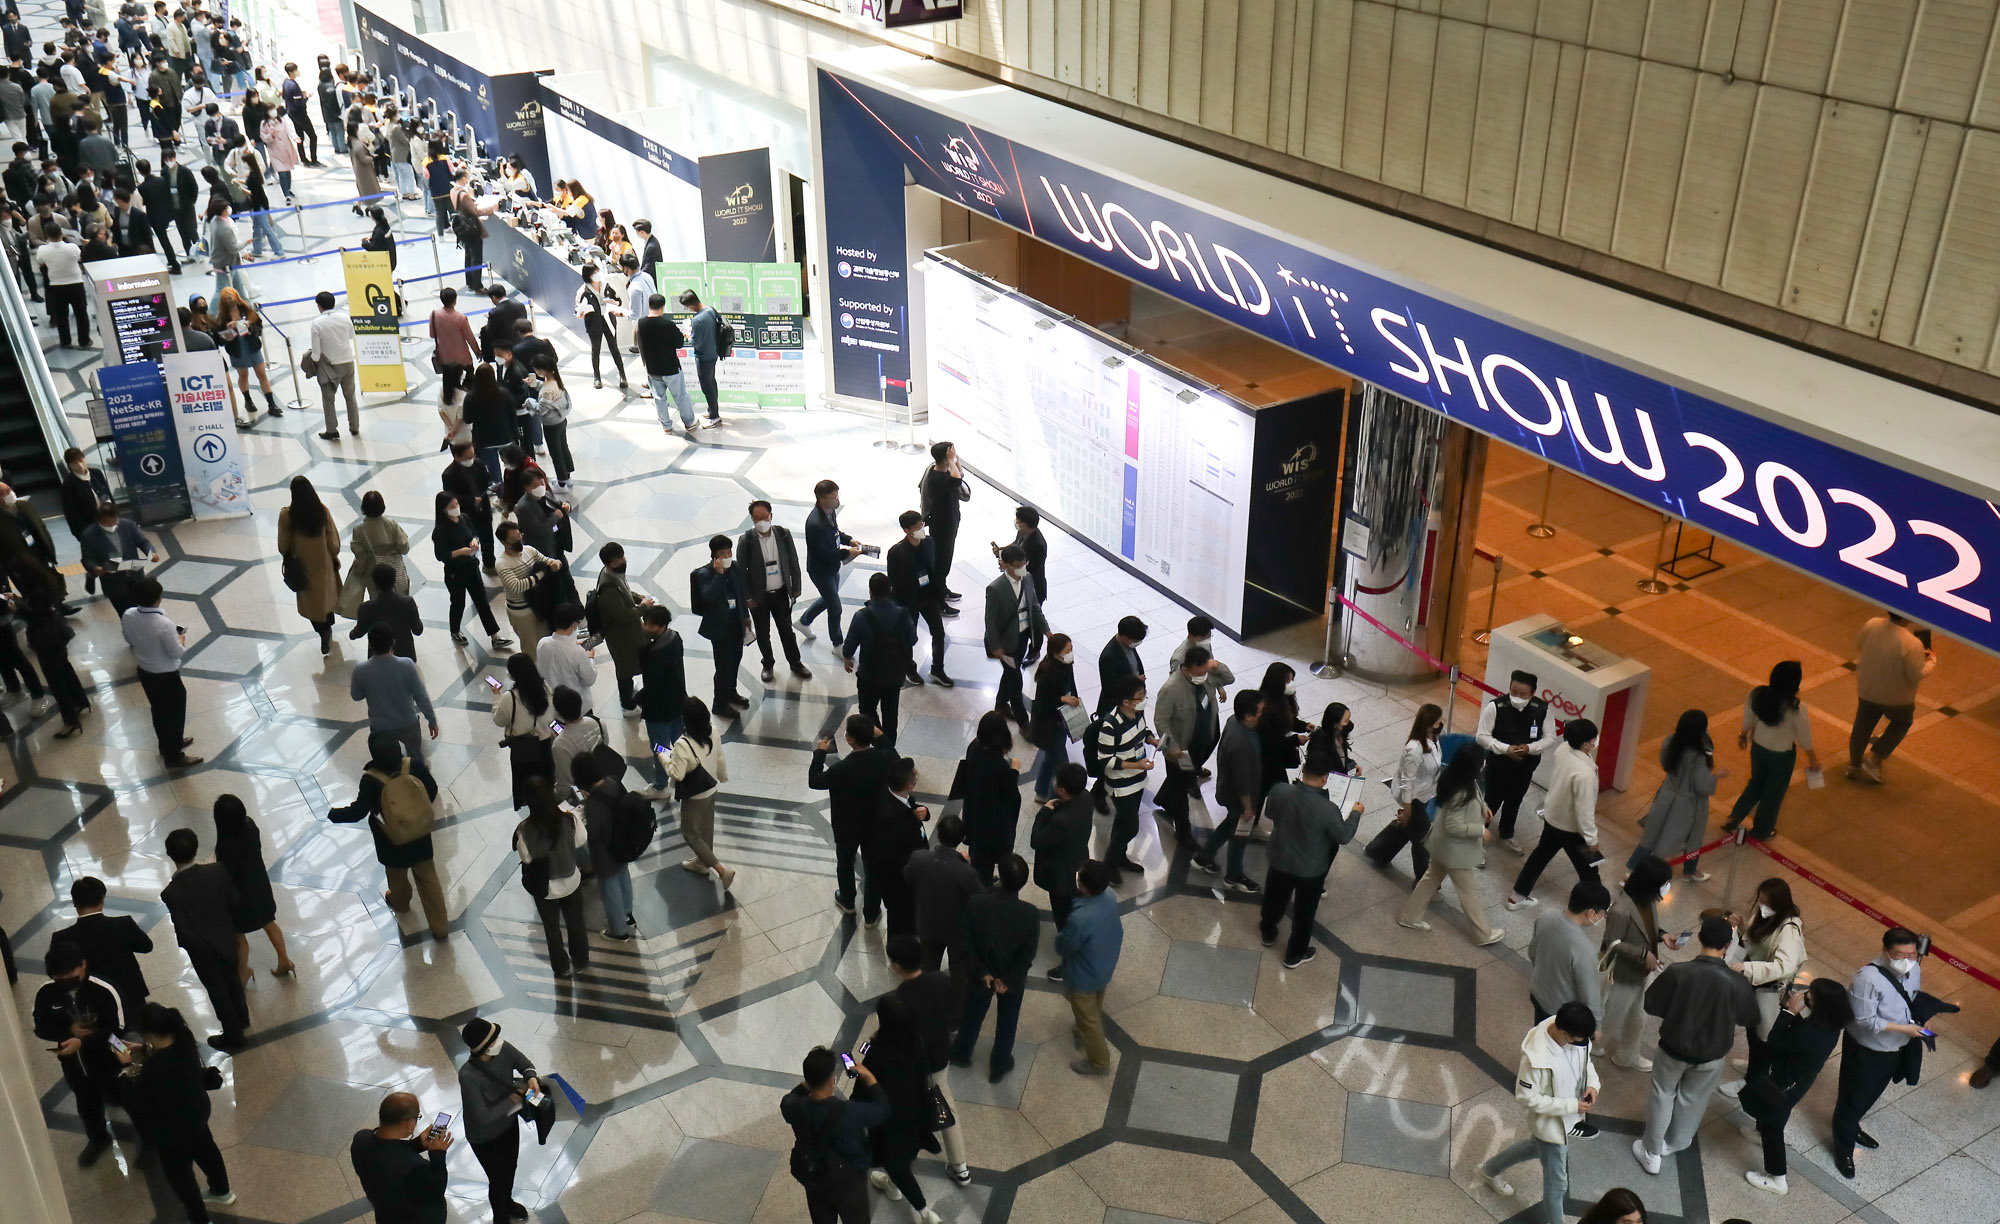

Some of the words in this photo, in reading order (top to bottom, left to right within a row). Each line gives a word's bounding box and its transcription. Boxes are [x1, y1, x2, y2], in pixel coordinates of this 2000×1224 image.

[516, 110, 536, 120] WIS
[941, 160, 970, 180] WORLD
[978, 176, 1006, 194] SHOW
[726, 196, 748, 206] WIS
[972, 188, 996, 206] 2022
[714, 208, 736, 217] WORLD
[744, 203, 763, 212] SHOW
[732, 218, 748, 226] 2022
[836, 246, 865, 258] Hosted
[866, 250, 877, 262] by
[838, 297, 882, 313] Supported
[883, 304, 894, 316] by
[180, 374, 214, 392] ICT
[108, 394, 134, 405] 2022
[174, 390, 226, 403] 기술사업화
[1039, 175, 1272, 316] WORLD
[1371, 308, 1667, 482] SHOW
[1682, 432, 1991, 623] 2022
[110, 400, 163, 416] NetSec-KR
[182, 401, 224, 414] 페스티벌
[1282, 459, 1309, 475] WIS
[1265, 477, 1293, 492] WORLD
[1949, 958, 1970, 972] coex
